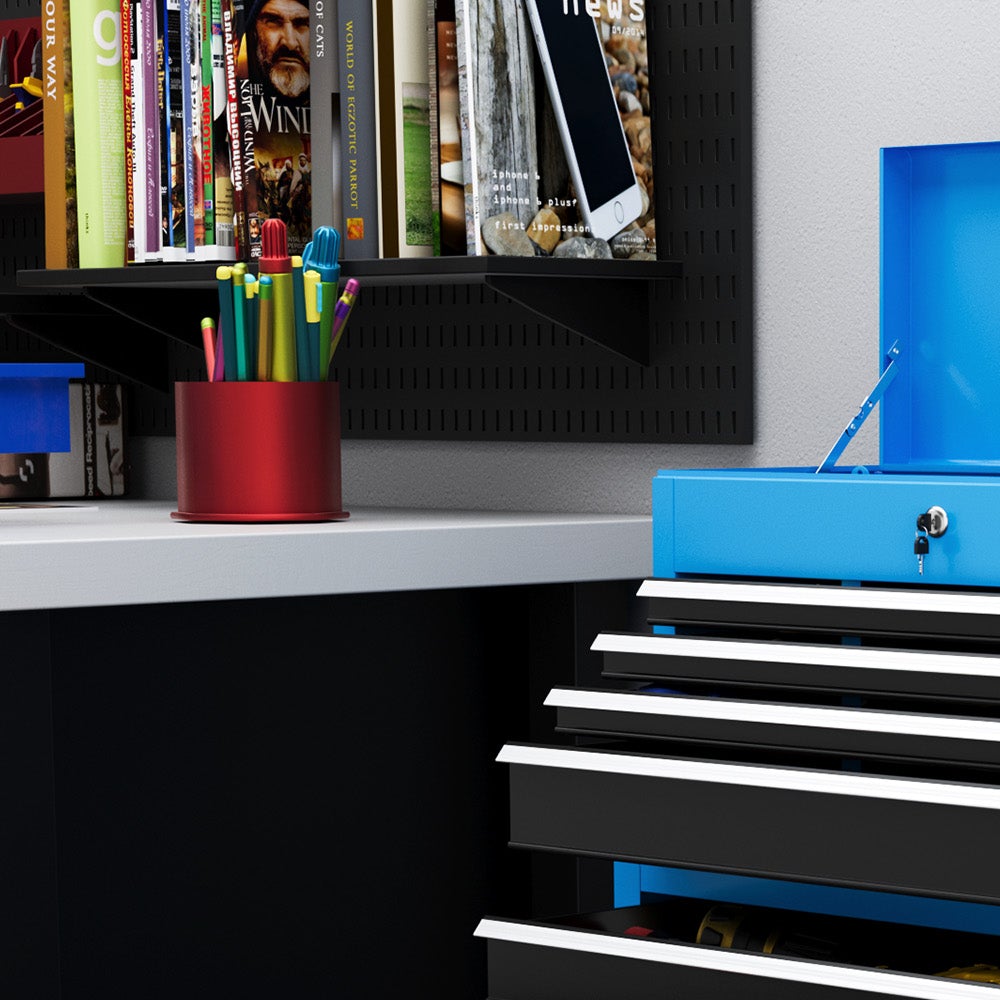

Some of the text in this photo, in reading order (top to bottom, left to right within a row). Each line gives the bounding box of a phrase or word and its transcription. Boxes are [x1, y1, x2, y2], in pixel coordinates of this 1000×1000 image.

[315, 0, 325, 58] OF CATS
[45, 1, 57, 101] OUR WAY
[224, 11, 236, 99] ВЛАДИМИР
[249, 83, 264, 96] HE
[345, 20, 358, 210] WORLD OF EGZOTIC PARROT
[202, 84, 212, 185] ЖИВОТНОЕ
[492, 169, 529, 181] iphone
[492, 180, 512, 191] and
[493, 195, 530, 207] iphone
[494, 221, 525, 231] first
